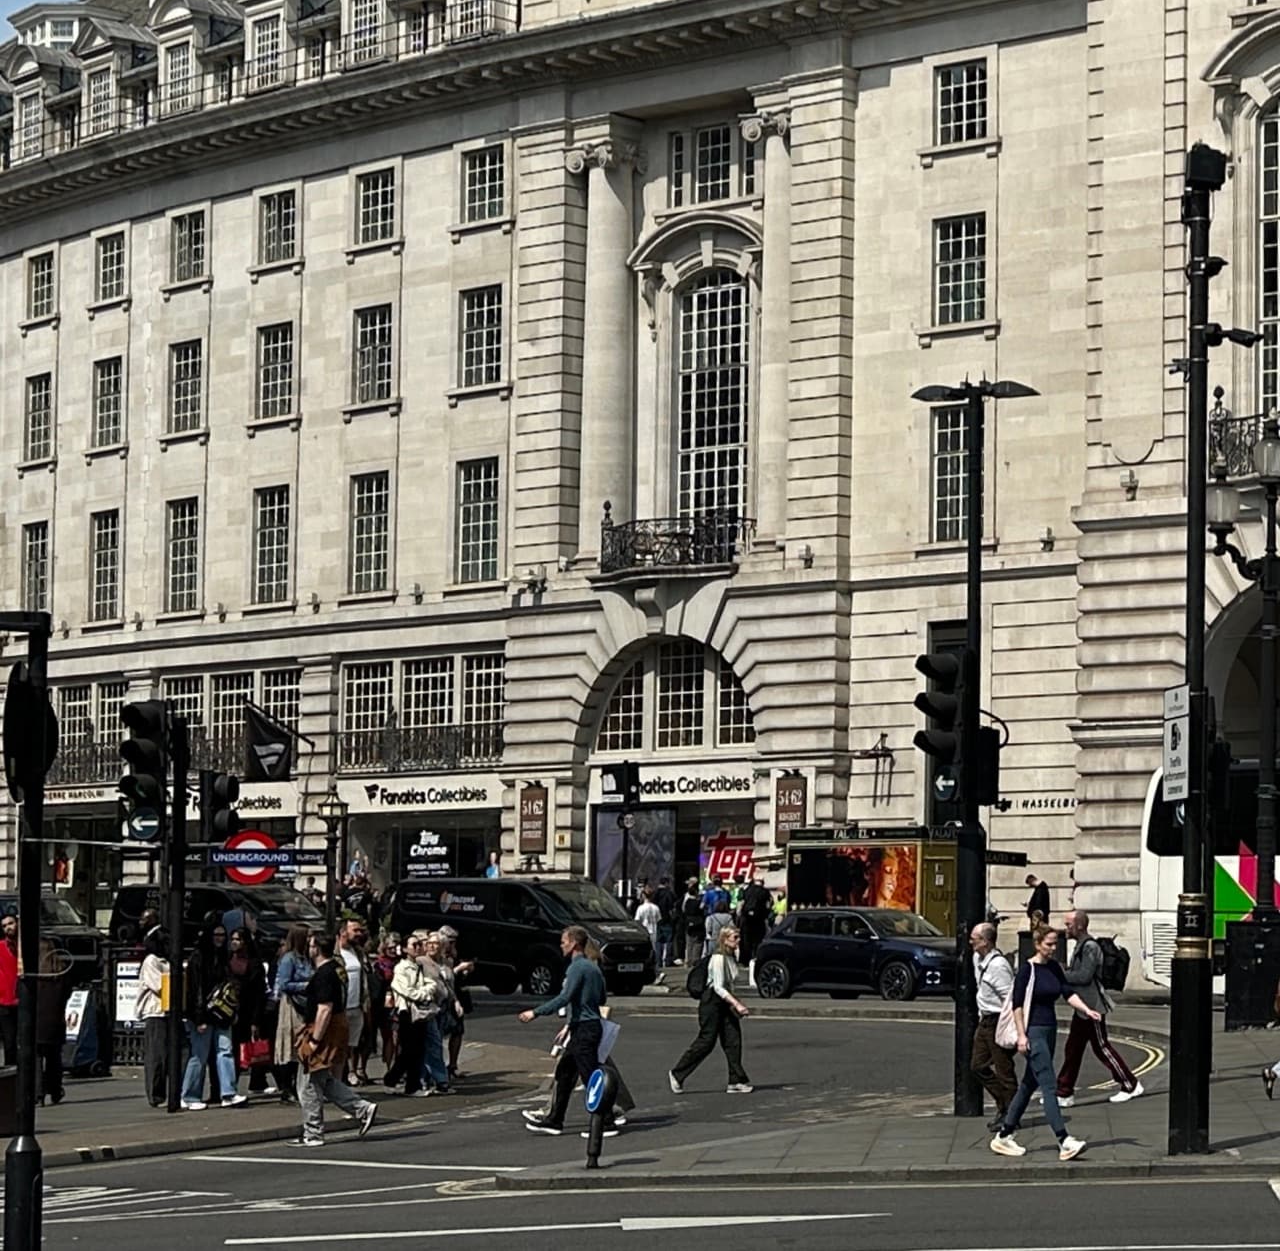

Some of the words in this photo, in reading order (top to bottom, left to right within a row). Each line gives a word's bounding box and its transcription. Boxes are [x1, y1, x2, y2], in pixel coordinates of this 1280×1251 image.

[638, 776, 675, 794] natics
[677, 775, 751, 793] Collectibles
[380, 786, 426, 806] Fanatics
[427, 785, 488, 804] Collectibles
[1022, 798, 1076, 809] HASSELBL
[212, 853, 290, 862] UNDERGROUND
